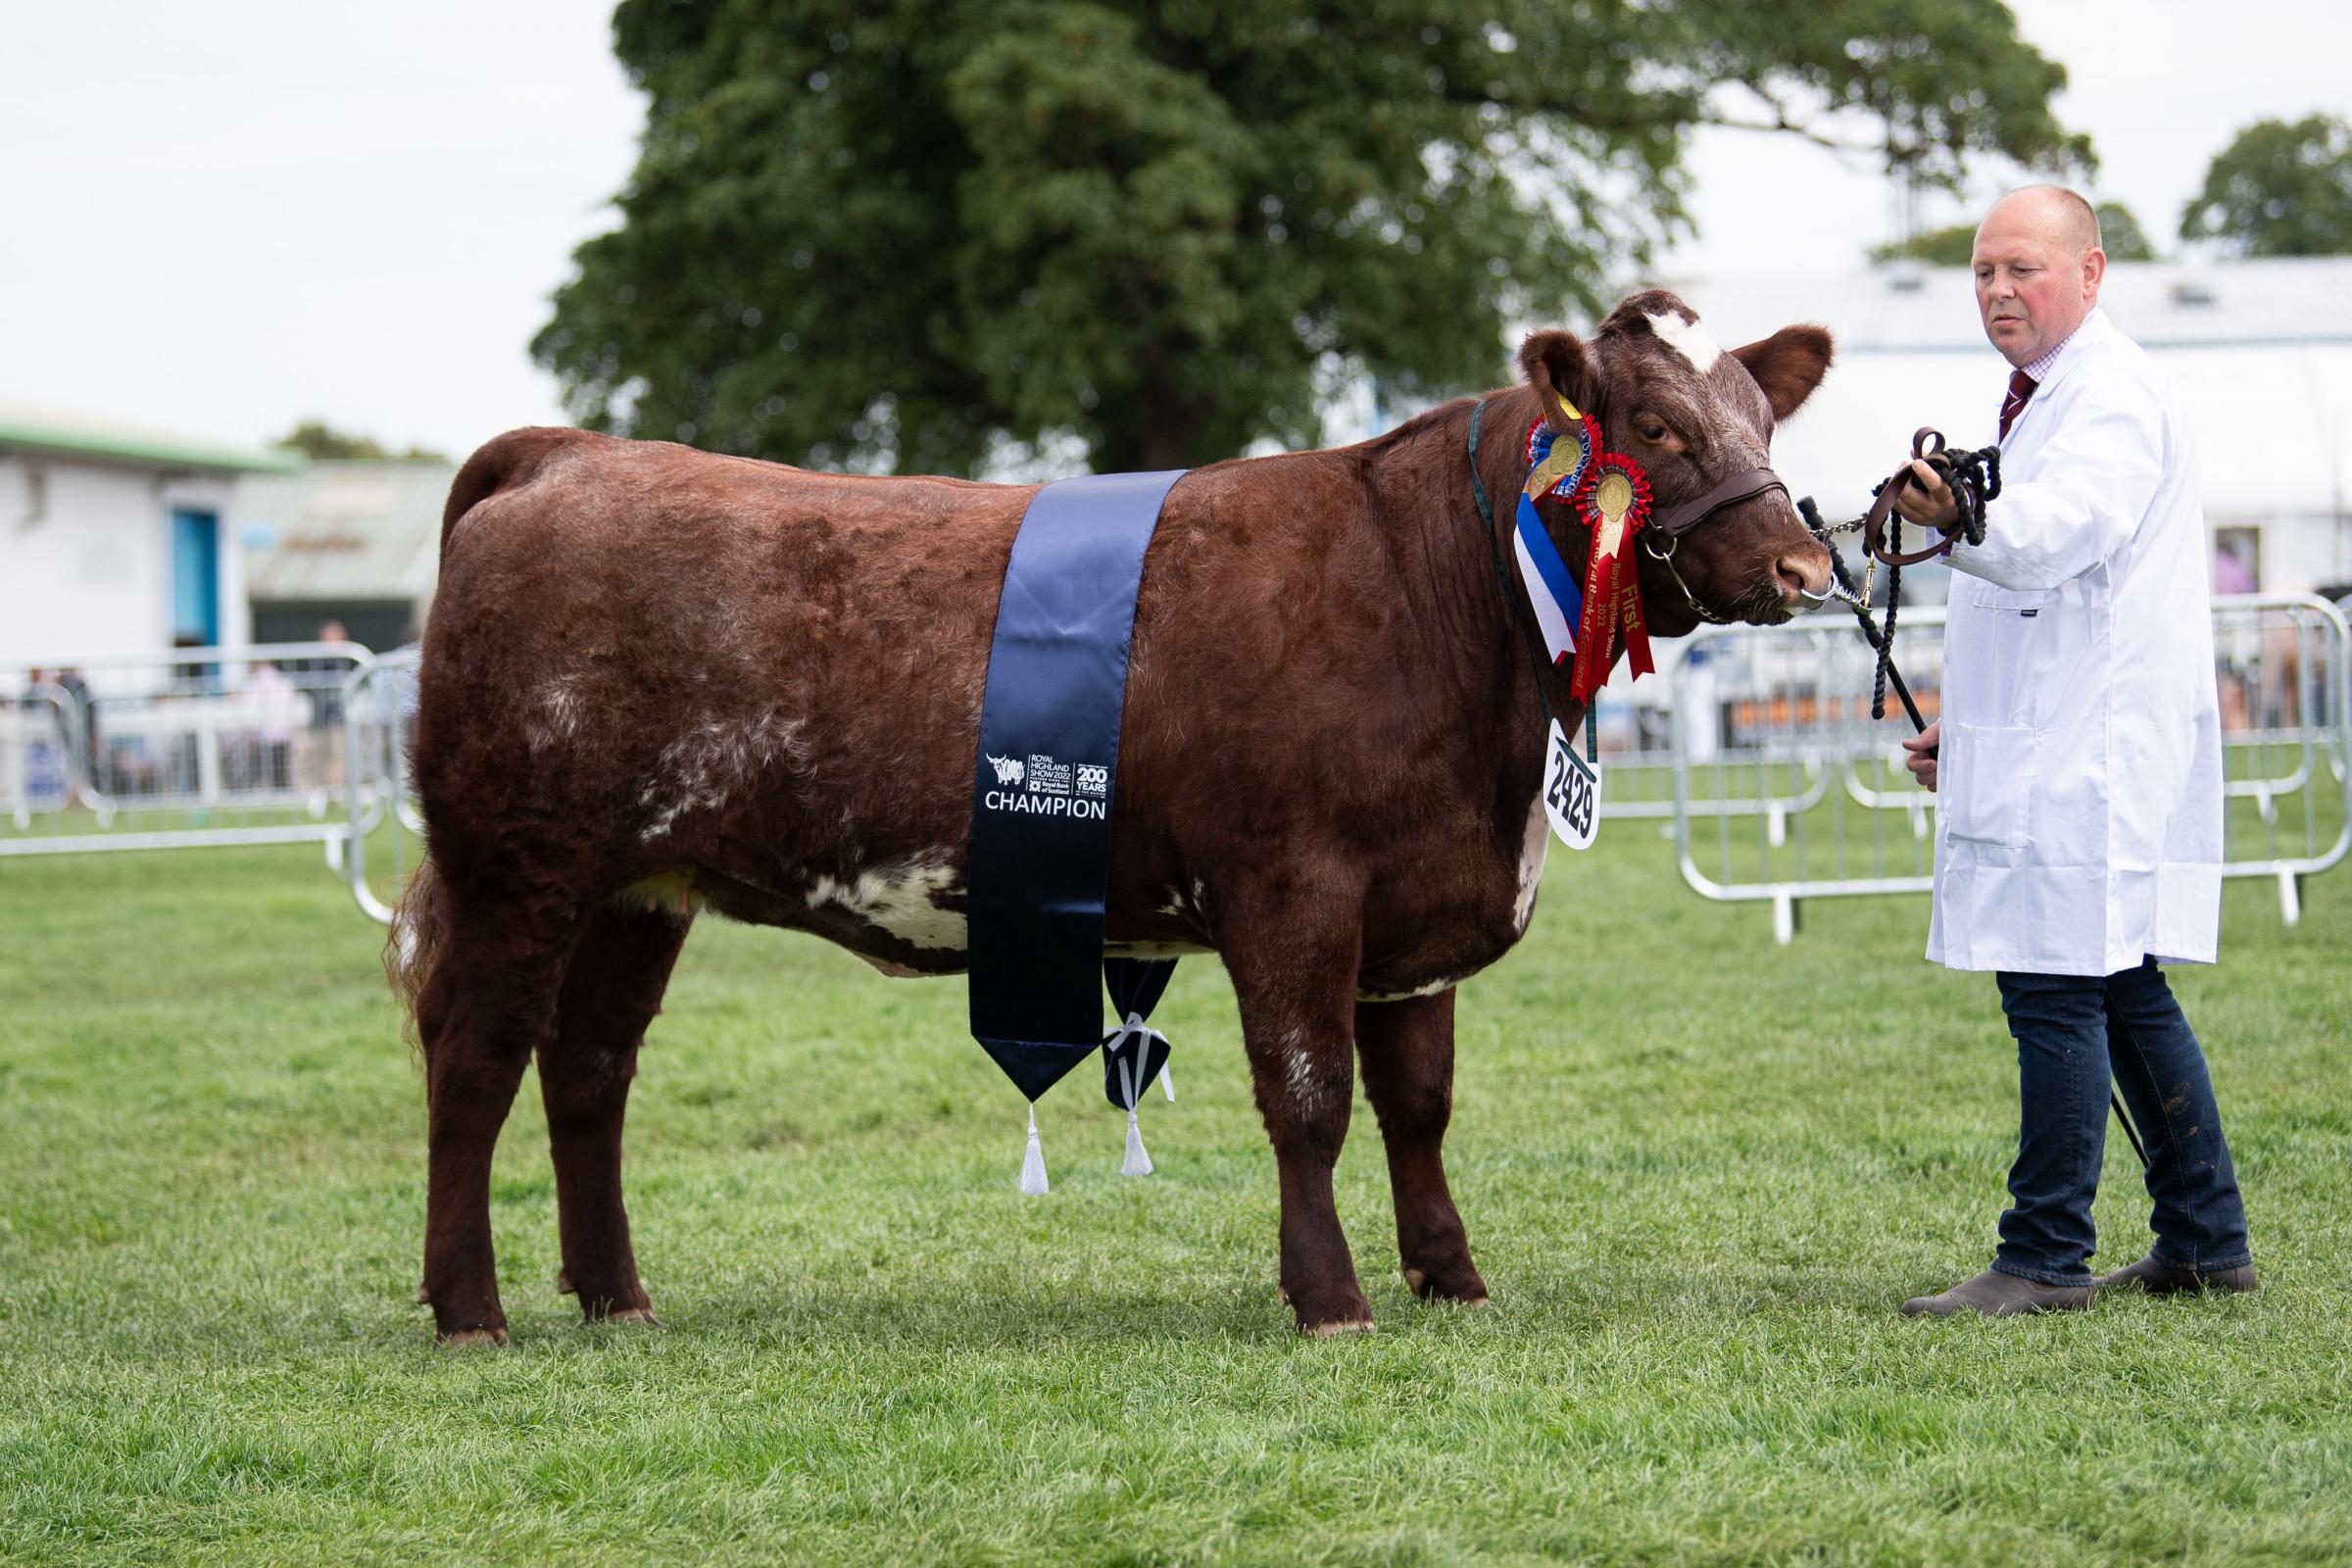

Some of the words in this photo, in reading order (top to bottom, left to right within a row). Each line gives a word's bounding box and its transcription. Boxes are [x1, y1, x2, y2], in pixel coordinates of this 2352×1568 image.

[1610, 562, 1621, 590] Royal
[1584, 583, 1597, 618] Bank
[1607, 591, 1619, 633] Highland
[1621, 582, 1642, 633] First
[1583, 617, 1592, 633] of
[1597, 603, 1606, 627] 2022
[1604, 633, 1615, 659] Show
[1576, 632, 1590, 688] Scotland
[1030, 761, 1070, 772] HIGHLAND
[1031, 754, 1054, 763] ROYAL
[1030, 768, 1054, 777] SHOW
[1077, 766, 1107, 784] 200
[1076, 780, 1106, 793] YEARS
[1546, 751, 1592, 839] 2429
[985, 791, 1106, 820] CHAMPION
